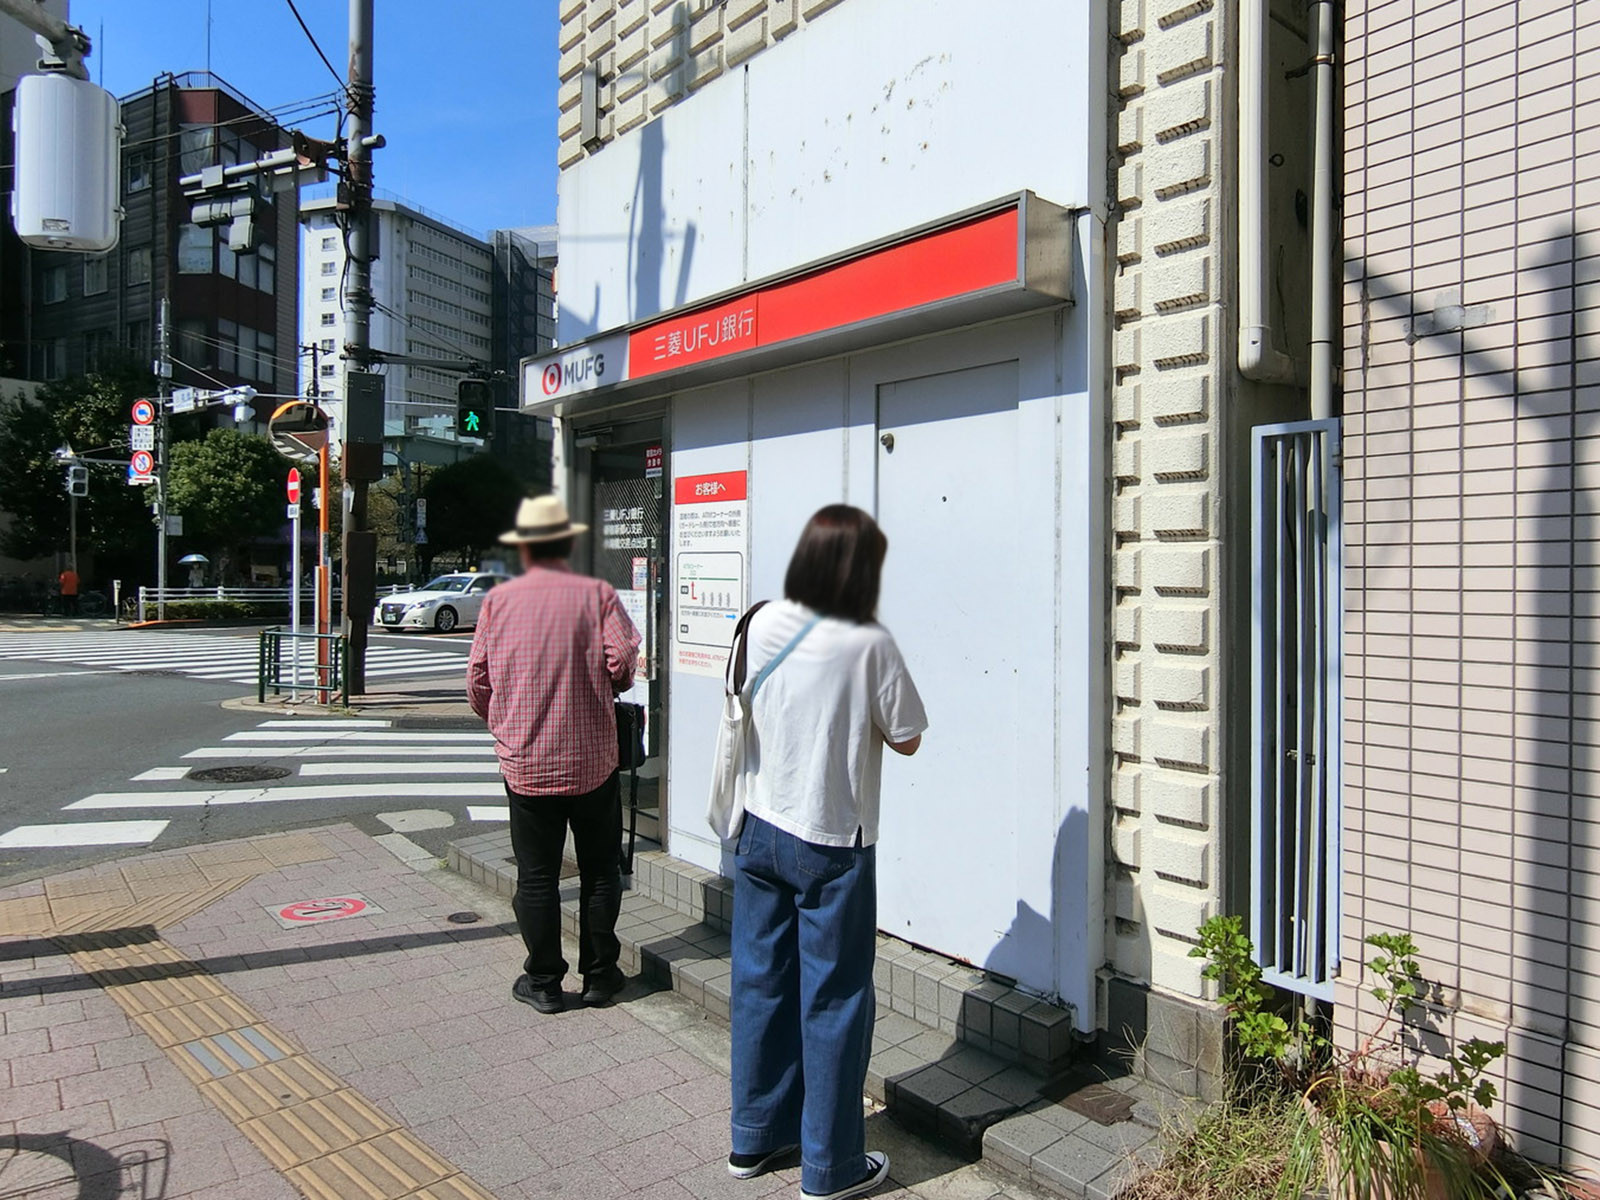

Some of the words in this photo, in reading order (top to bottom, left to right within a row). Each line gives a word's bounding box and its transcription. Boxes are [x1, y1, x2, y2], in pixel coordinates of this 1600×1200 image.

[654, 309, 753, 360] 三菱UFJ銀行
[564, 353, 605, 386] MUFG
[695, 481, 726, 496] お客様へ
